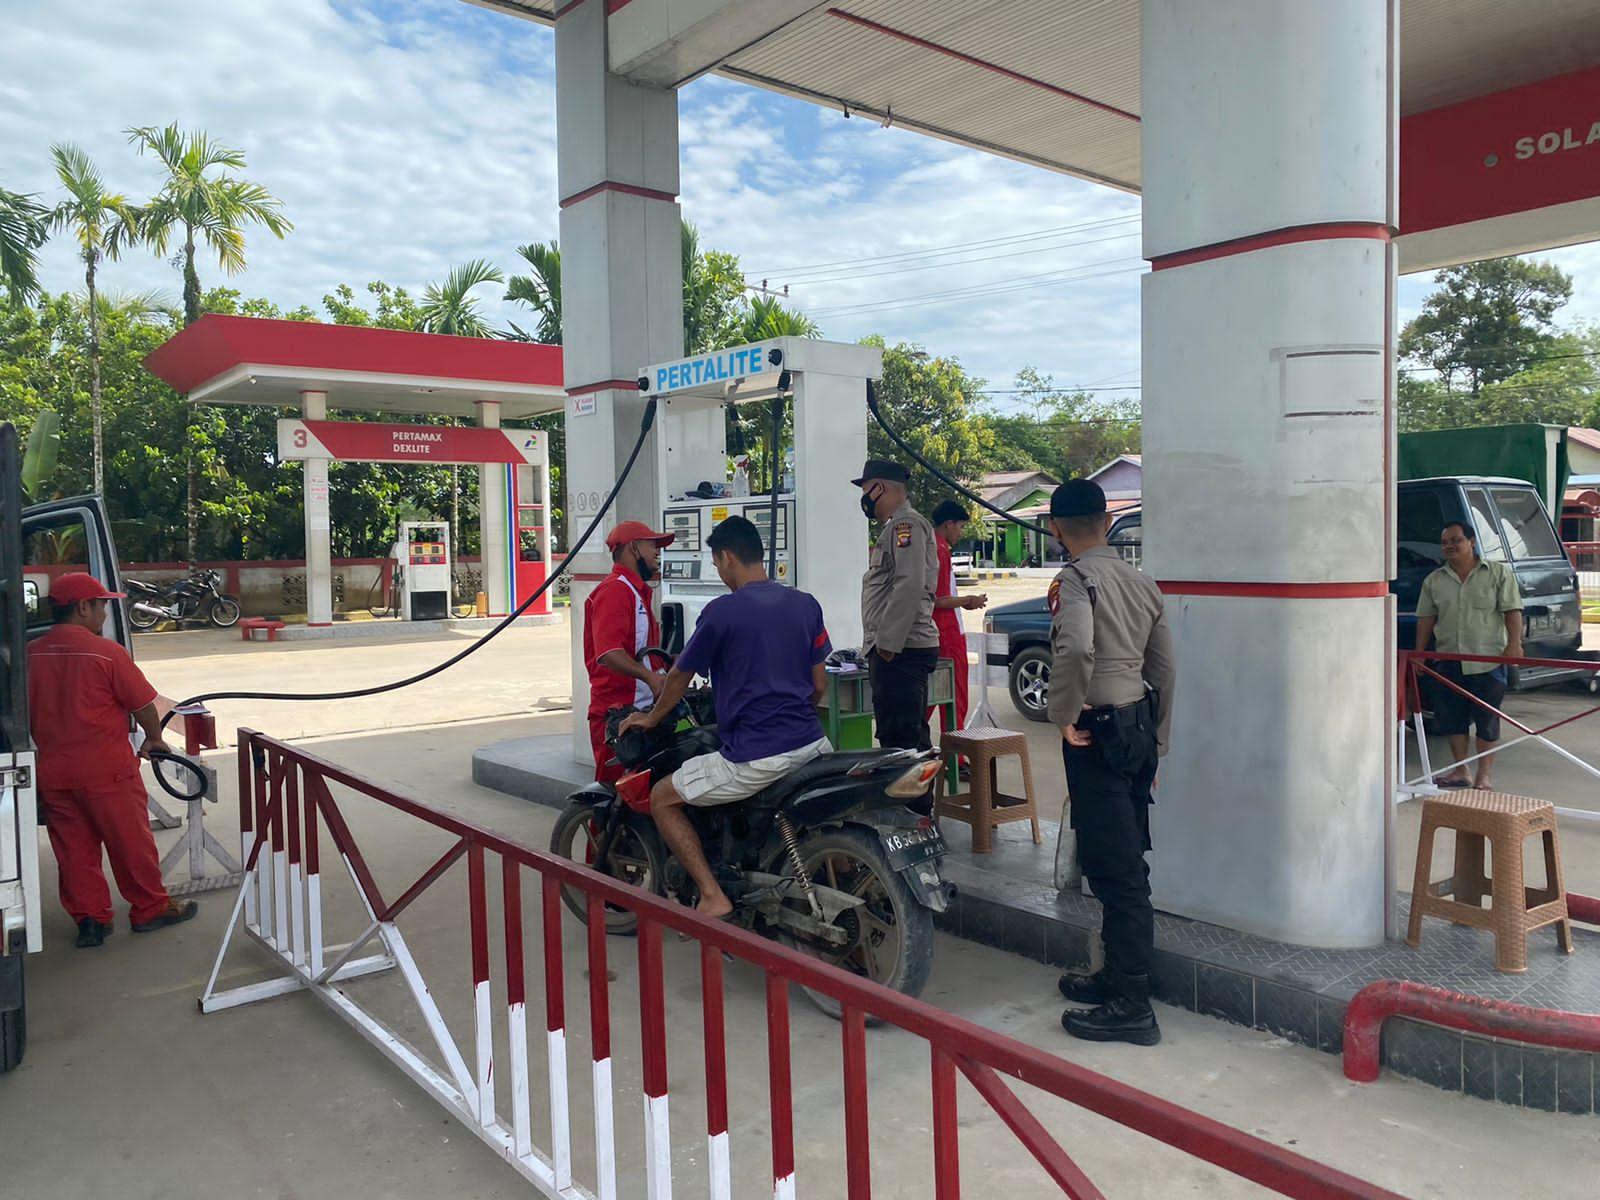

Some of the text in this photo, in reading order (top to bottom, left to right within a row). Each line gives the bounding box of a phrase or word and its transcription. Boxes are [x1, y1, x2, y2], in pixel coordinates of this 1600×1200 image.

[657, 347, 762, 391] PERTALITE
[293, 429, 307, 448] 3
[393, 432, 442, 442] PERTAMAX
[393, 444, 430, 453] DEXLITE
